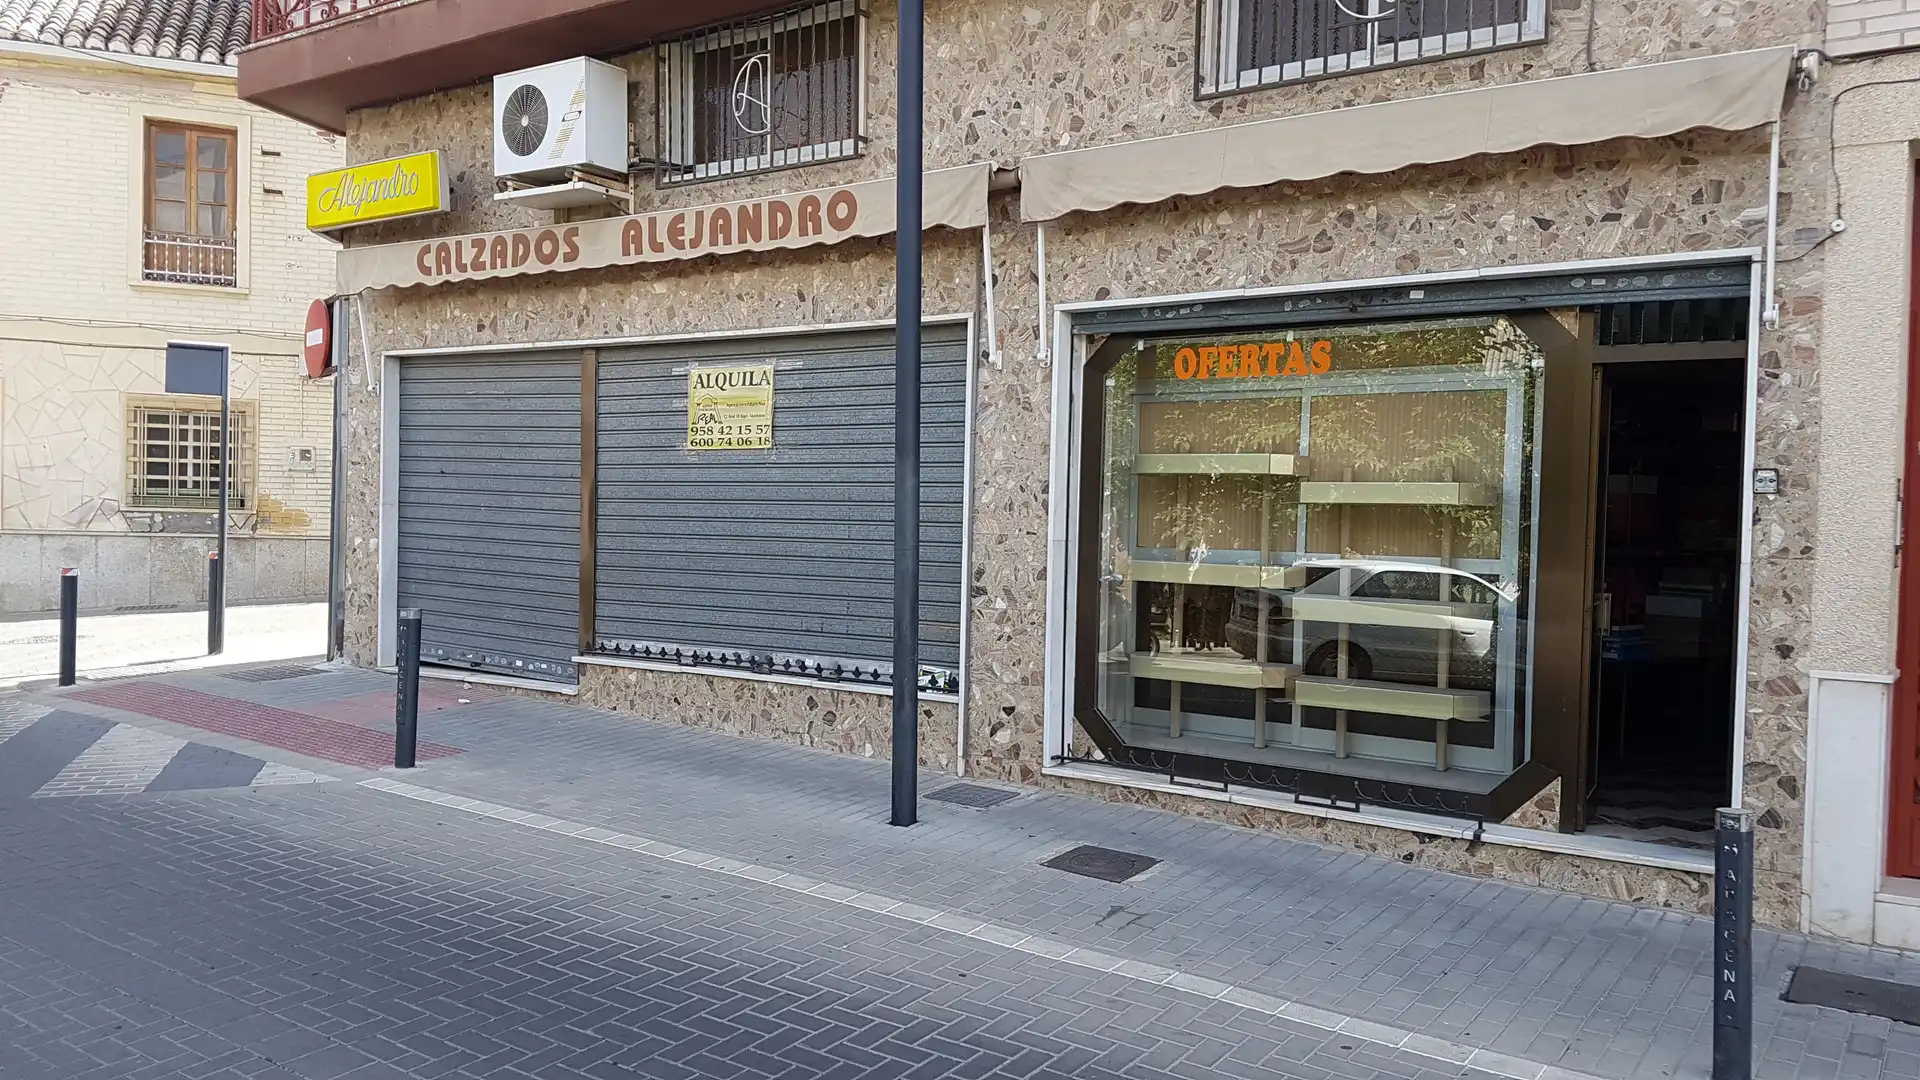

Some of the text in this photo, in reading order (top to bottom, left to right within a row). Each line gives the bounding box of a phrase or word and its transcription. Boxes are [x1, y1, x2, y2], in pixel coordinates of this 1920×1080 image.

[318, 163, 419, 216] Alejandro
[416, 190, 858, 277] CALZADOS ALEJANDRO
[1174, 340, 1332, 381] OFERTAS
[693, 370, 771, 391] ALQUILA
[690, 424, 771, 436] 958 42 15 57
[690, 436, 771, 447] 600 74 06 18
